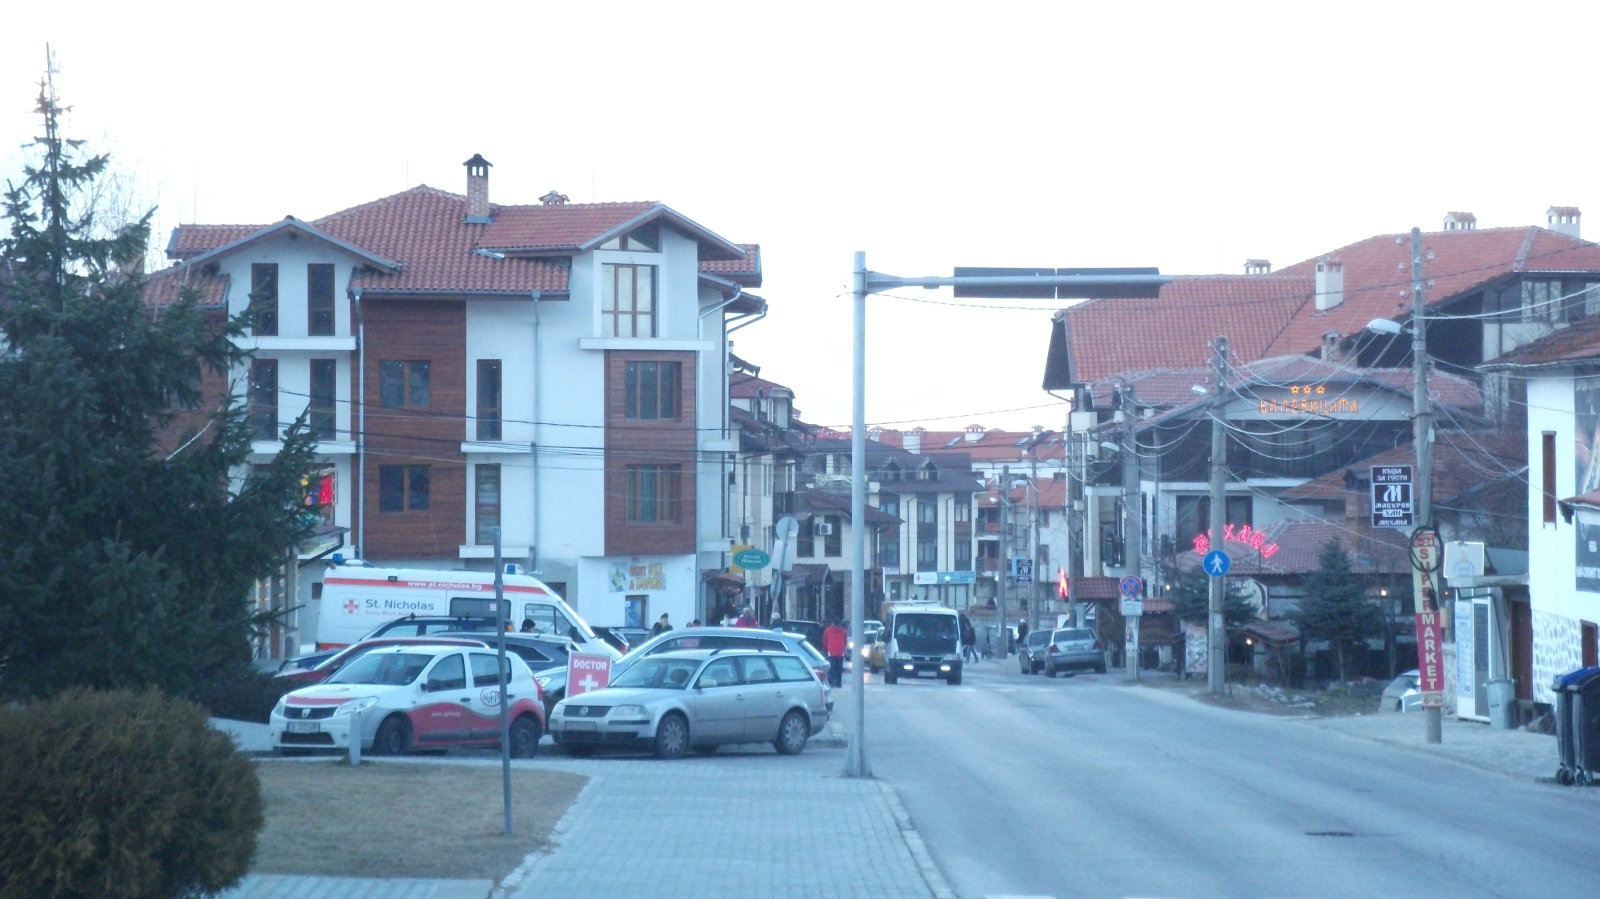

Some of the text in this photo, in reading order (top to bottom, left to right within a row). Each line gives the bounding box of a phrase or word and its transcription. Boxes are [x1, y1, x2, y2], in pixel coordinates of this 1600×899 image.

[1193, 523, 1279, 559] МХАНА
[365, 599, 434, 611] St. Nicholas
[573, 659, 608, 671] DOCTOR
